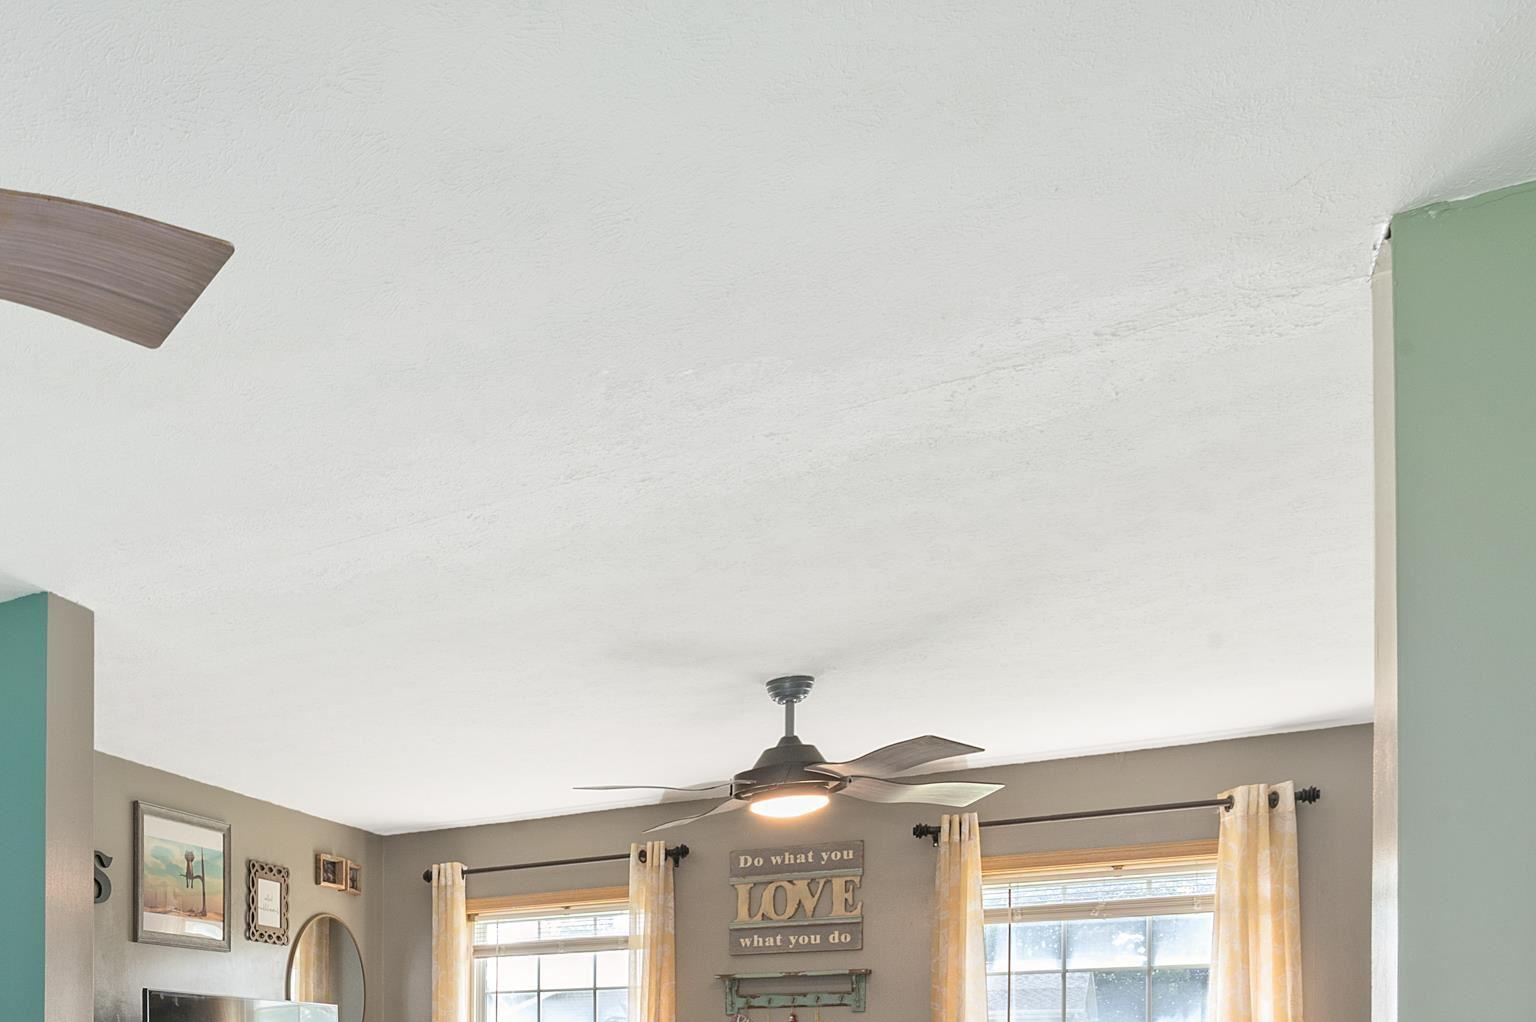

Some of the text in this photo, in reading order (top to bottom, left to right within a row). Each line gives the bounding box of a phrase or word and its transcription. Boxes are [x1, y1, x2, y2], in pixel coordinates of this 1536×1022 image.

[738, 849, 854, 868] Do what you
[733, 876, 863, 922] LOVE
[739, 931, 852, 948] what you do
